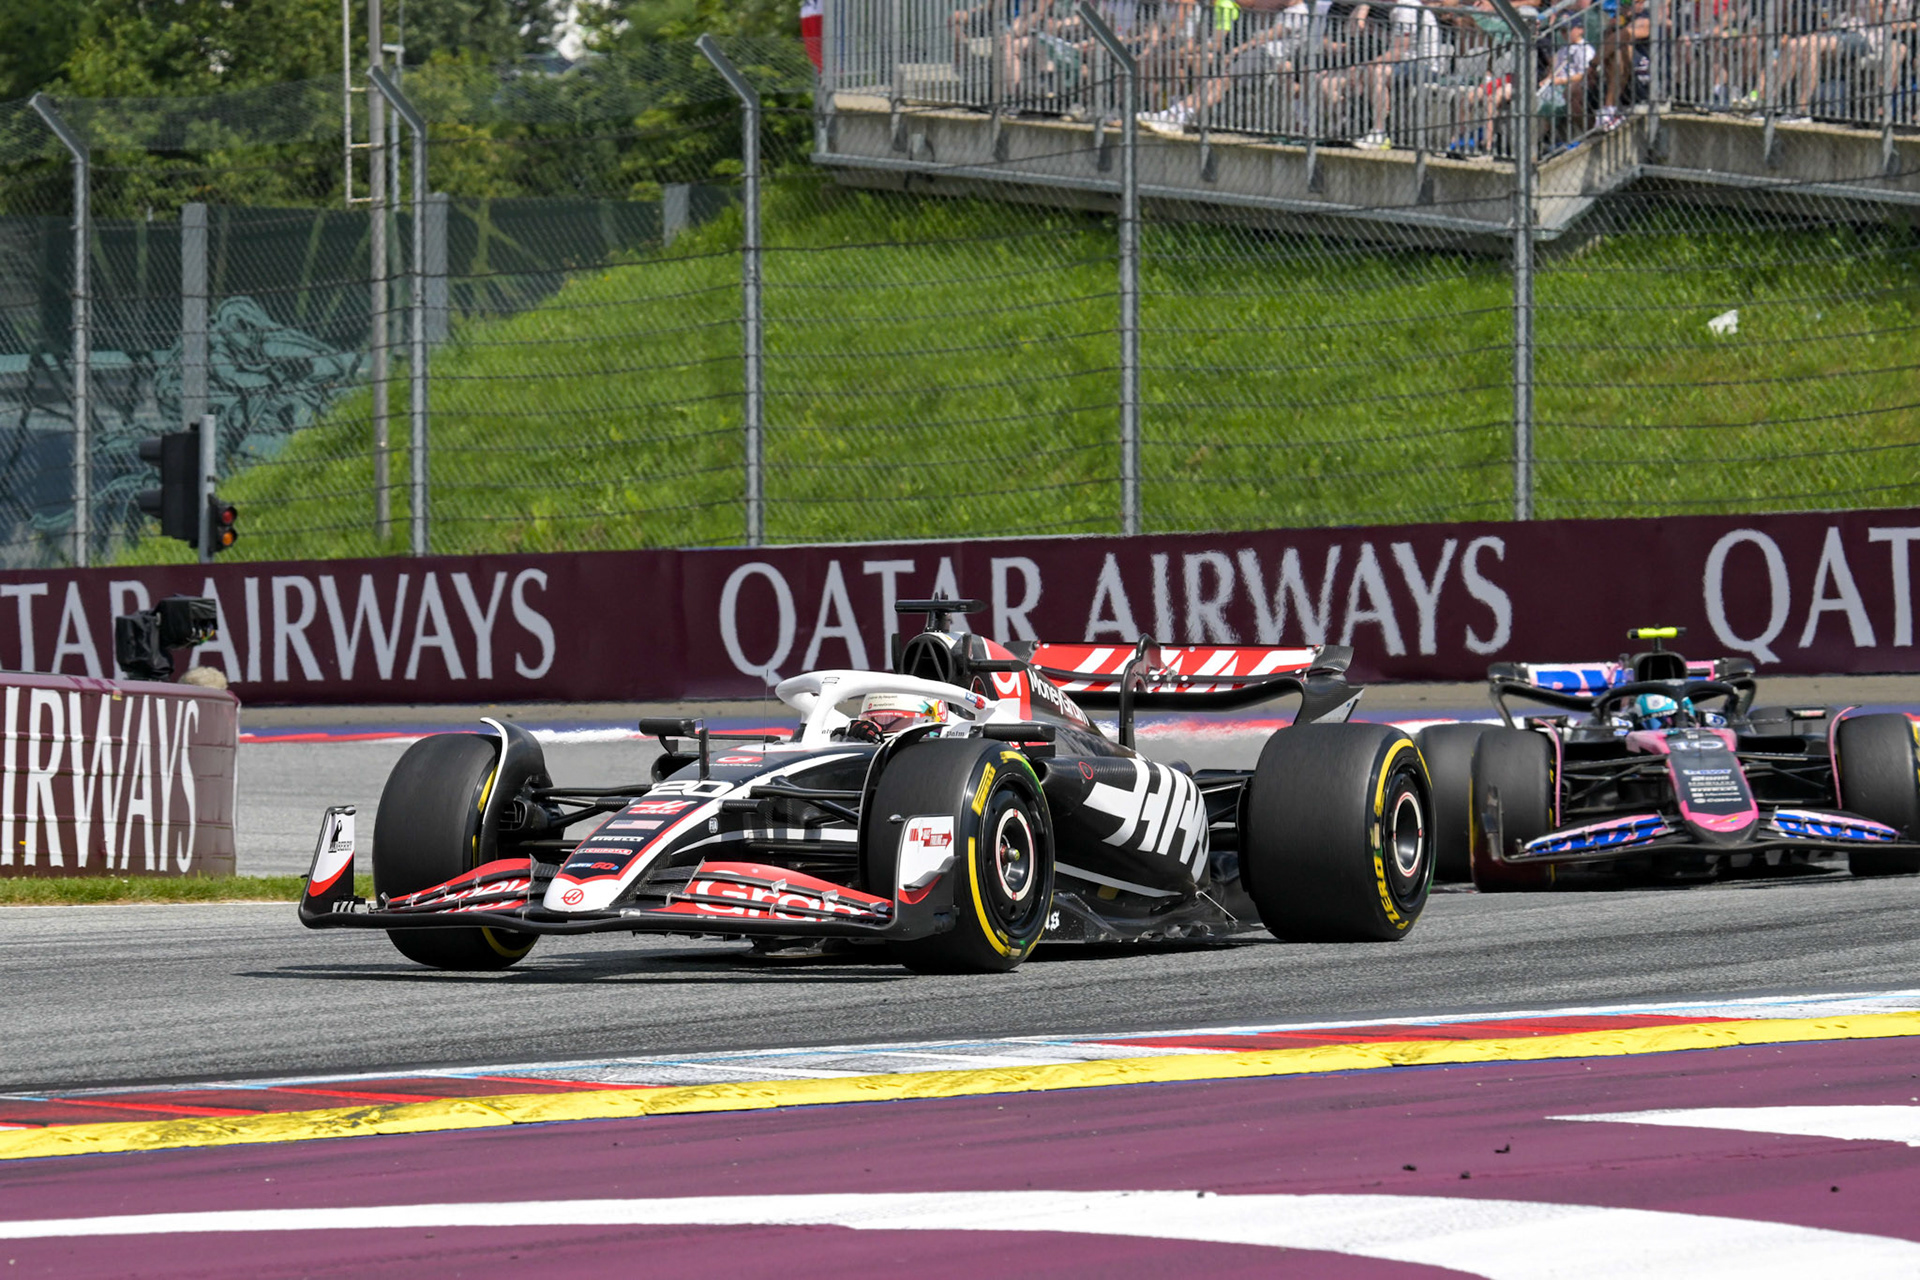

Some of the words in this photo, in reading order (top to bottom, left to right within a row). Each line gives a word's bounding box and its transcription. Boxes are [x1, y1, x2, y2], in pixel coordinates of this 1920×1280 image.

[0, 580, 152, 681] TA
[190, 568, 555, 683] AIRWAYS
[719, 556, 1042, 687] QATAR
[1084, 536, 1513, 656] AIRWAYS
[1703, 527, 1920, 664] QAT
[1027, 668, 1090, 726] MoneyGram
[0, 686, 199, 873] IRWAYS
[641, 779, 735, 798] 20
[1669, 741, 1724, 750] 10
[1373, 855, 1400, 924] ZERO
